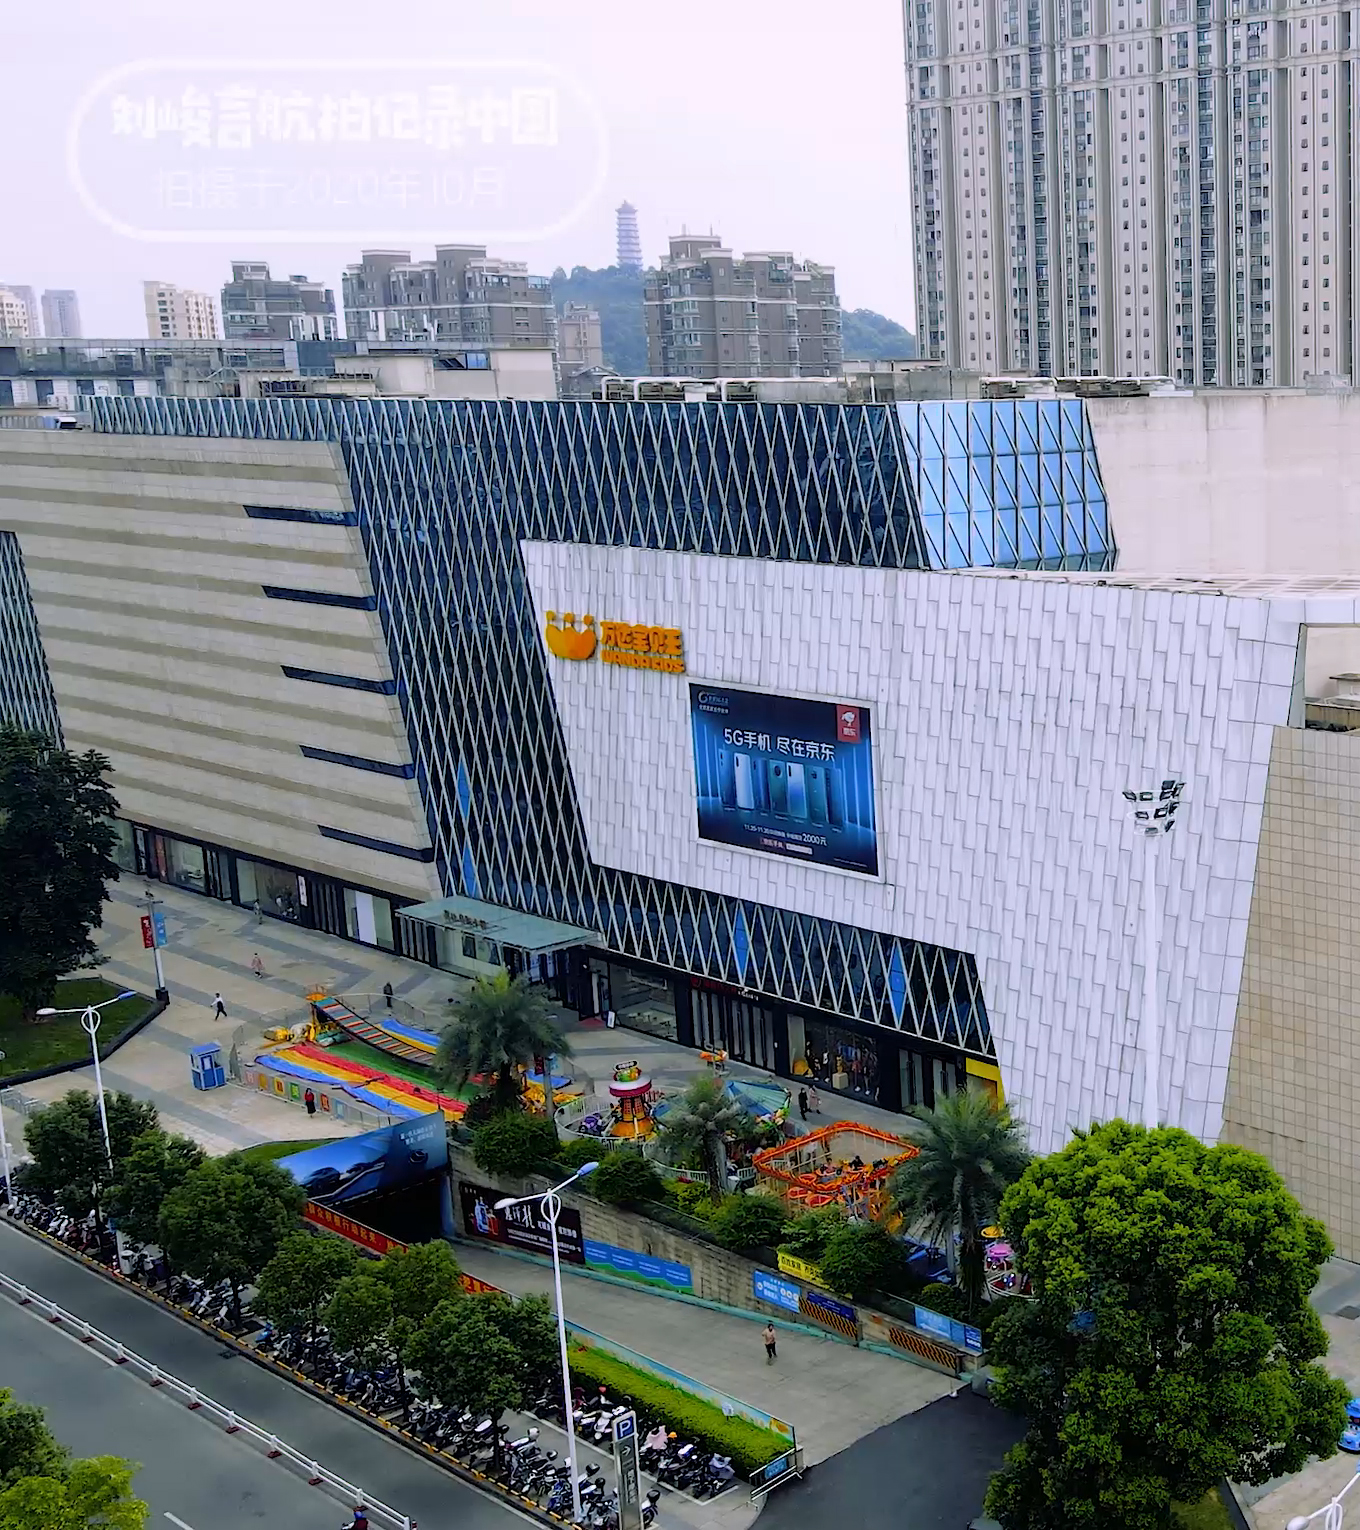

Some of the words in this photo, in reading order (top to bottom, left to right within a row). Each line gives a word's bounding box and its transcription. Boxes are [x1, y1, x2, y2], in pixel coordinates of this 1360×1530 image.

[724, 728, 772, 753] 5G手机
[776, 737, 835, 762] 尽在京东
[619, 1419, 631, 1438] P
